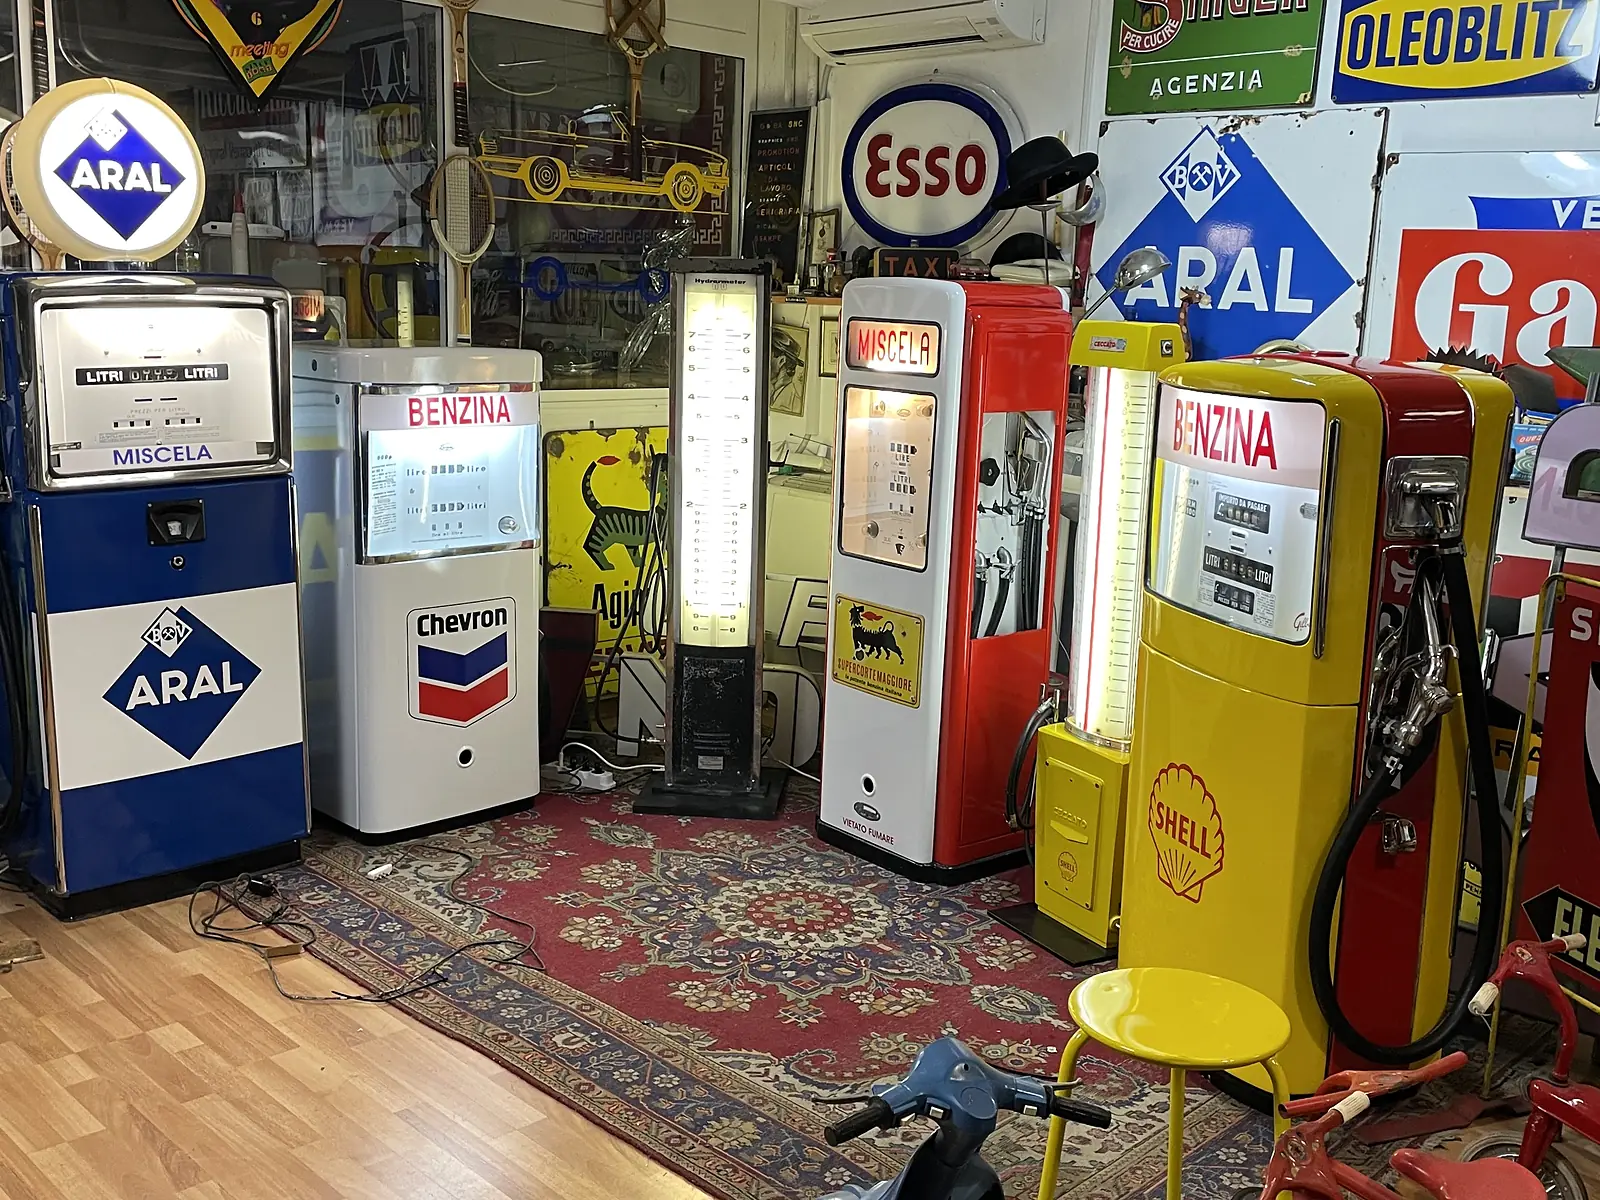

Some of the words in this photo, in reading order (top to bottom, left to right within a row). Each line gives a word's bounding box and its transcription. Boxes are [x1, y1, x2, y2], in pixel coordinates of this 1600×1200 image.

[251, 12, 263, 26] 6
[1123, 33, 1142, 48] PER
[1144, 19, 1179, 48] CUCIRE
[1346, 0, 1592, 70] OLEOBLITZ
[230, 41, 293, 58] meeting
[1150, 69, 1263, 97] AGENZIA
[757, 147, 800, 157] PROMOTION
[71, 159, 172, 193] ARAL
[758, 162, 796, 172] ARTICOLI
[760, 184, 792, 193] LAVORO
[858, 328, 930, 366] MISCELA
[1163, 341, 1172, 354] C
[86, 370, 123, 383] LITRI
[184, 368, 218, 379] LITRI
[408, 395, 511, 427] BENZINA
[1172, 399, 1278, 470] BENZINA
[113, 444, 213, 466] MISCELA
[895, 454, 910, 463] LIRE
[893, 474, 911, 484] LITRI
[1247, 500, 1267, 512] PAGARE
[1205, 552, 1221, 565] LITRI
[1254, 568, 1272, 585] LITRI
[417, 607, 508, 637] Chevron
[1570, 607, 1600, 646] S
[125, 661, 244, 711] ARAL
[838, 658, 912, 692] SUPERCORTEMAGGIORE
[867, 681, 884, 691] benzina
[885, 686, 902, 697] italiana
[1053, 806, 1088, 830] CECCATO
[842, 817, 867, 834] VIETATO
[868, 828, 894, 845] FUMARE
[1155, 801, 1211, 860] SHELL
[1060, 859, 1075, 873] SHELL
